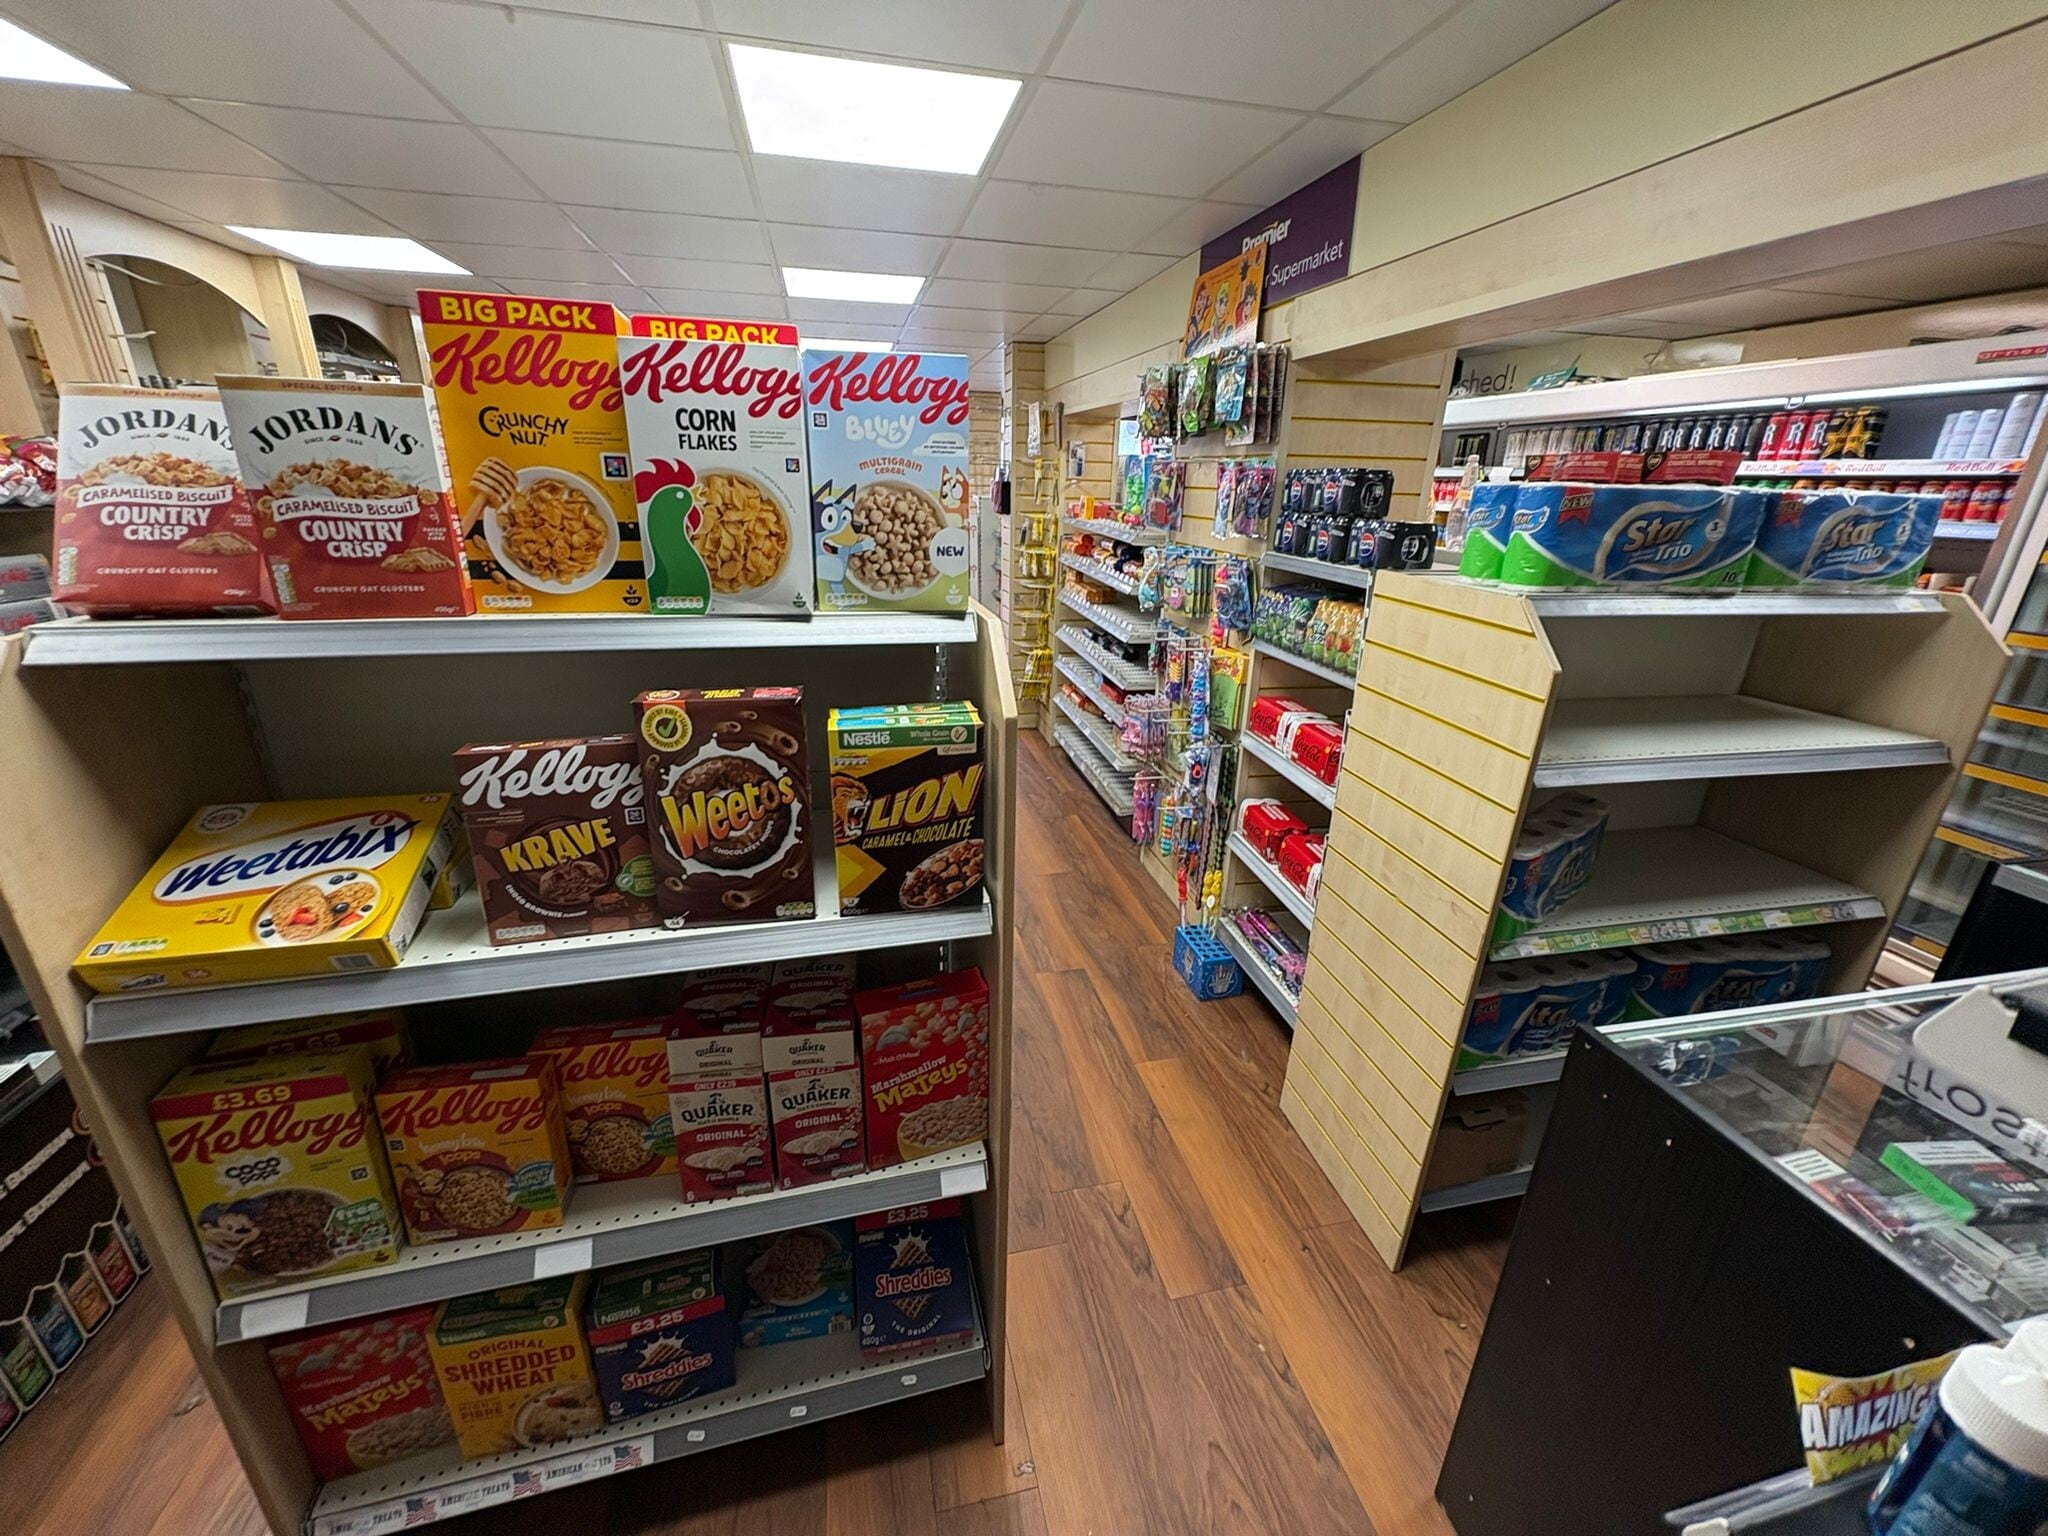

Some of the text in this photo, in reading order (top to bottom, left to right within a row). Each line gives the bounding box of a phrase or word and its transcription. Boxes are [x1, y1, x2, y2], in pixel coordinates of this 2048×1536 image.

[1242, 218, 1292, 253] Premier
[1271, 239, 1344, 286] Supermarket
[439, 297, 597, 330] BIG PACK
[649, 320, 780, 345] BIG PACK
[281, 382, 363, 393] SPECIAL EDITION
[249, 406, 420, 456] JORDANS
[479, 406, 569, 437] CRUNCHY
[675, 408, 737, 432] CORN
[511, 430, 548, 447] NUT
[678, 434, 738, 451] FLAKES
[846, 415, 915, 449] BLUEY
[1763, 423, 1776, 445] R
[1789, 421, 1805, 446] R
[1812, 420, 1828, 444] R
[858, 457, 922, 473] MULTIGRAIN
[1946, 462, 1997, 472] Red Bull
[100, 505, 212, 526] COUNTRY
[299, 520, 404, 541] COUNTRY
[1623, 516, 1697, 552] Star
[1822, 518, 1887, 551] Star
[936, 546, 965, 557] NEW
[1655, 541, 1692, 561] Trio
[1854, 544, 1884, 562] Trio
[97, 567, 219, 575] CRUNCHY OAT CLUSTERS
[314, 585, 358, 594] CRUNCHY
[380, 585, 426, 593] CLUSTERS
[910, 730, 931, 739] Whole
[867, 763, 984, 832] LION
[661, 774, 796, 858] Weetos
[862, 831, 906, 850] CARAMEL
[912, 815, 976, 843] CHOCOLATE
[500, 817, 617, 873] KRAVE
[160, 819, 423, 898] Weetabix
[781, 963, 845, 978] QUAKER
[702, 980, 748, 992] ORIGINAL
[789, 979, 836, 990] ORIGINAL
[695, 1043, 733, 1057] QUAKER
[788, 1042, 825, 1056] QUAKER
[699, 1059, 732, 1069] ORIGINAL
[792, 1057, 825, 1066] ORIGINAL
[870, 1055, 947, 1094] Marshmallow
[873, 1058, 969, 1114] Mateys
[212, 1085, 292, 1111] £3.69
[781, 1087, 850, 1111] QUAKER
[681, 1103, 754, 1123] QUAKER
[795, 1114, 843, 1129] ORIGINAL
[696, 1129, 746, 1143] ORIGINAL
[784, 1178, 792, 1187] 6
[687, 1191, 695, 1200] 6
[887, 1205, 929, 1224] £3.25
[875, 1267, 953, 1299] Shreddies
[630, 1309, 685, 1335] £3.25
[891, 1313, 943, 1336] THE ORIGINAL
[468, 1339, 545, 1360] ORIGINAL
[444, 1344, 576, 1383] SHREDDED
[621, 1352, 715, 1392] Shreddies
[471, 1365, 556, 1396] WHEAT
[305, 1373, 424, 1434] Mateys
[1800, 1387, 1931, 1450] AMAZING
